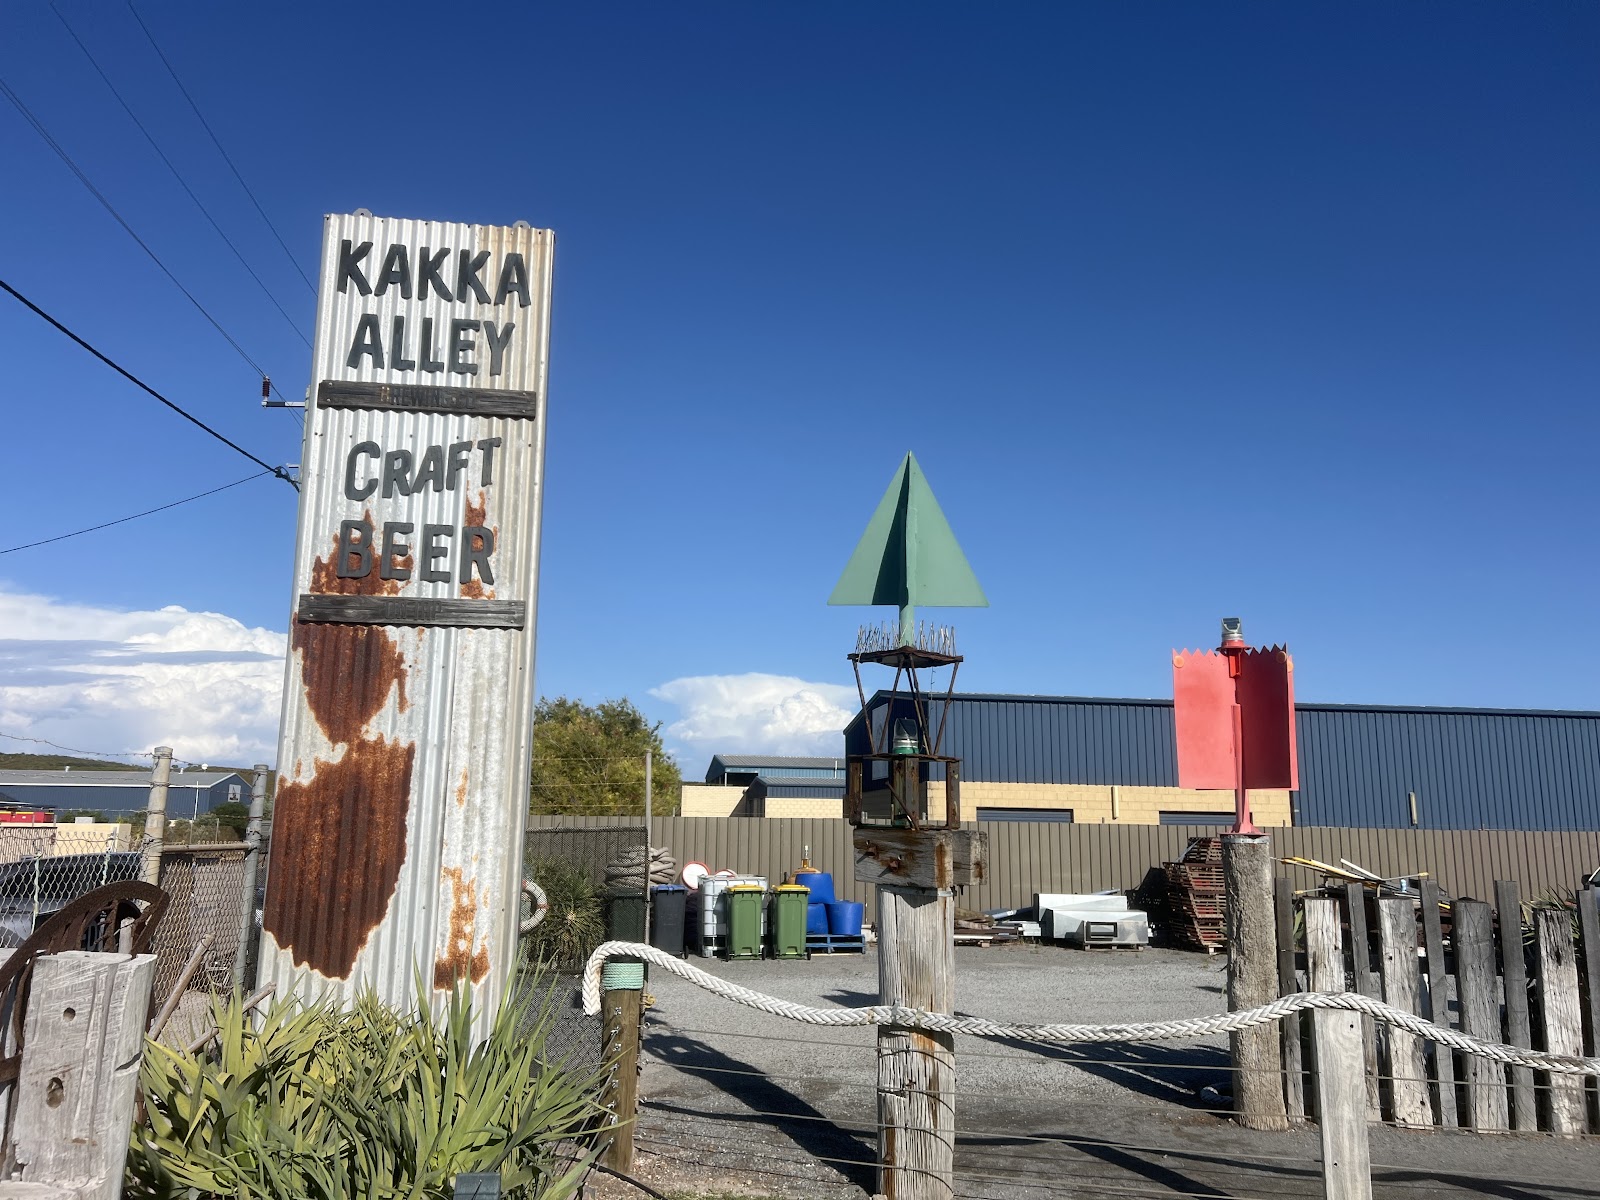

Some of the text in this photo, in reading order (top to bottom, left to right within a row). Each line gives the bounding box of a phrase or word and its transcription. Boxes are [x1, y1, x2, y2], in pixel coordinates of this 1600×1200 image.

[337, 239, 531, 308] KAKKA
[346, 313, 515, 376] ALLEY
[344, 437, 501, 501] CRAFT
[336, 519, 495, 585] BEER
